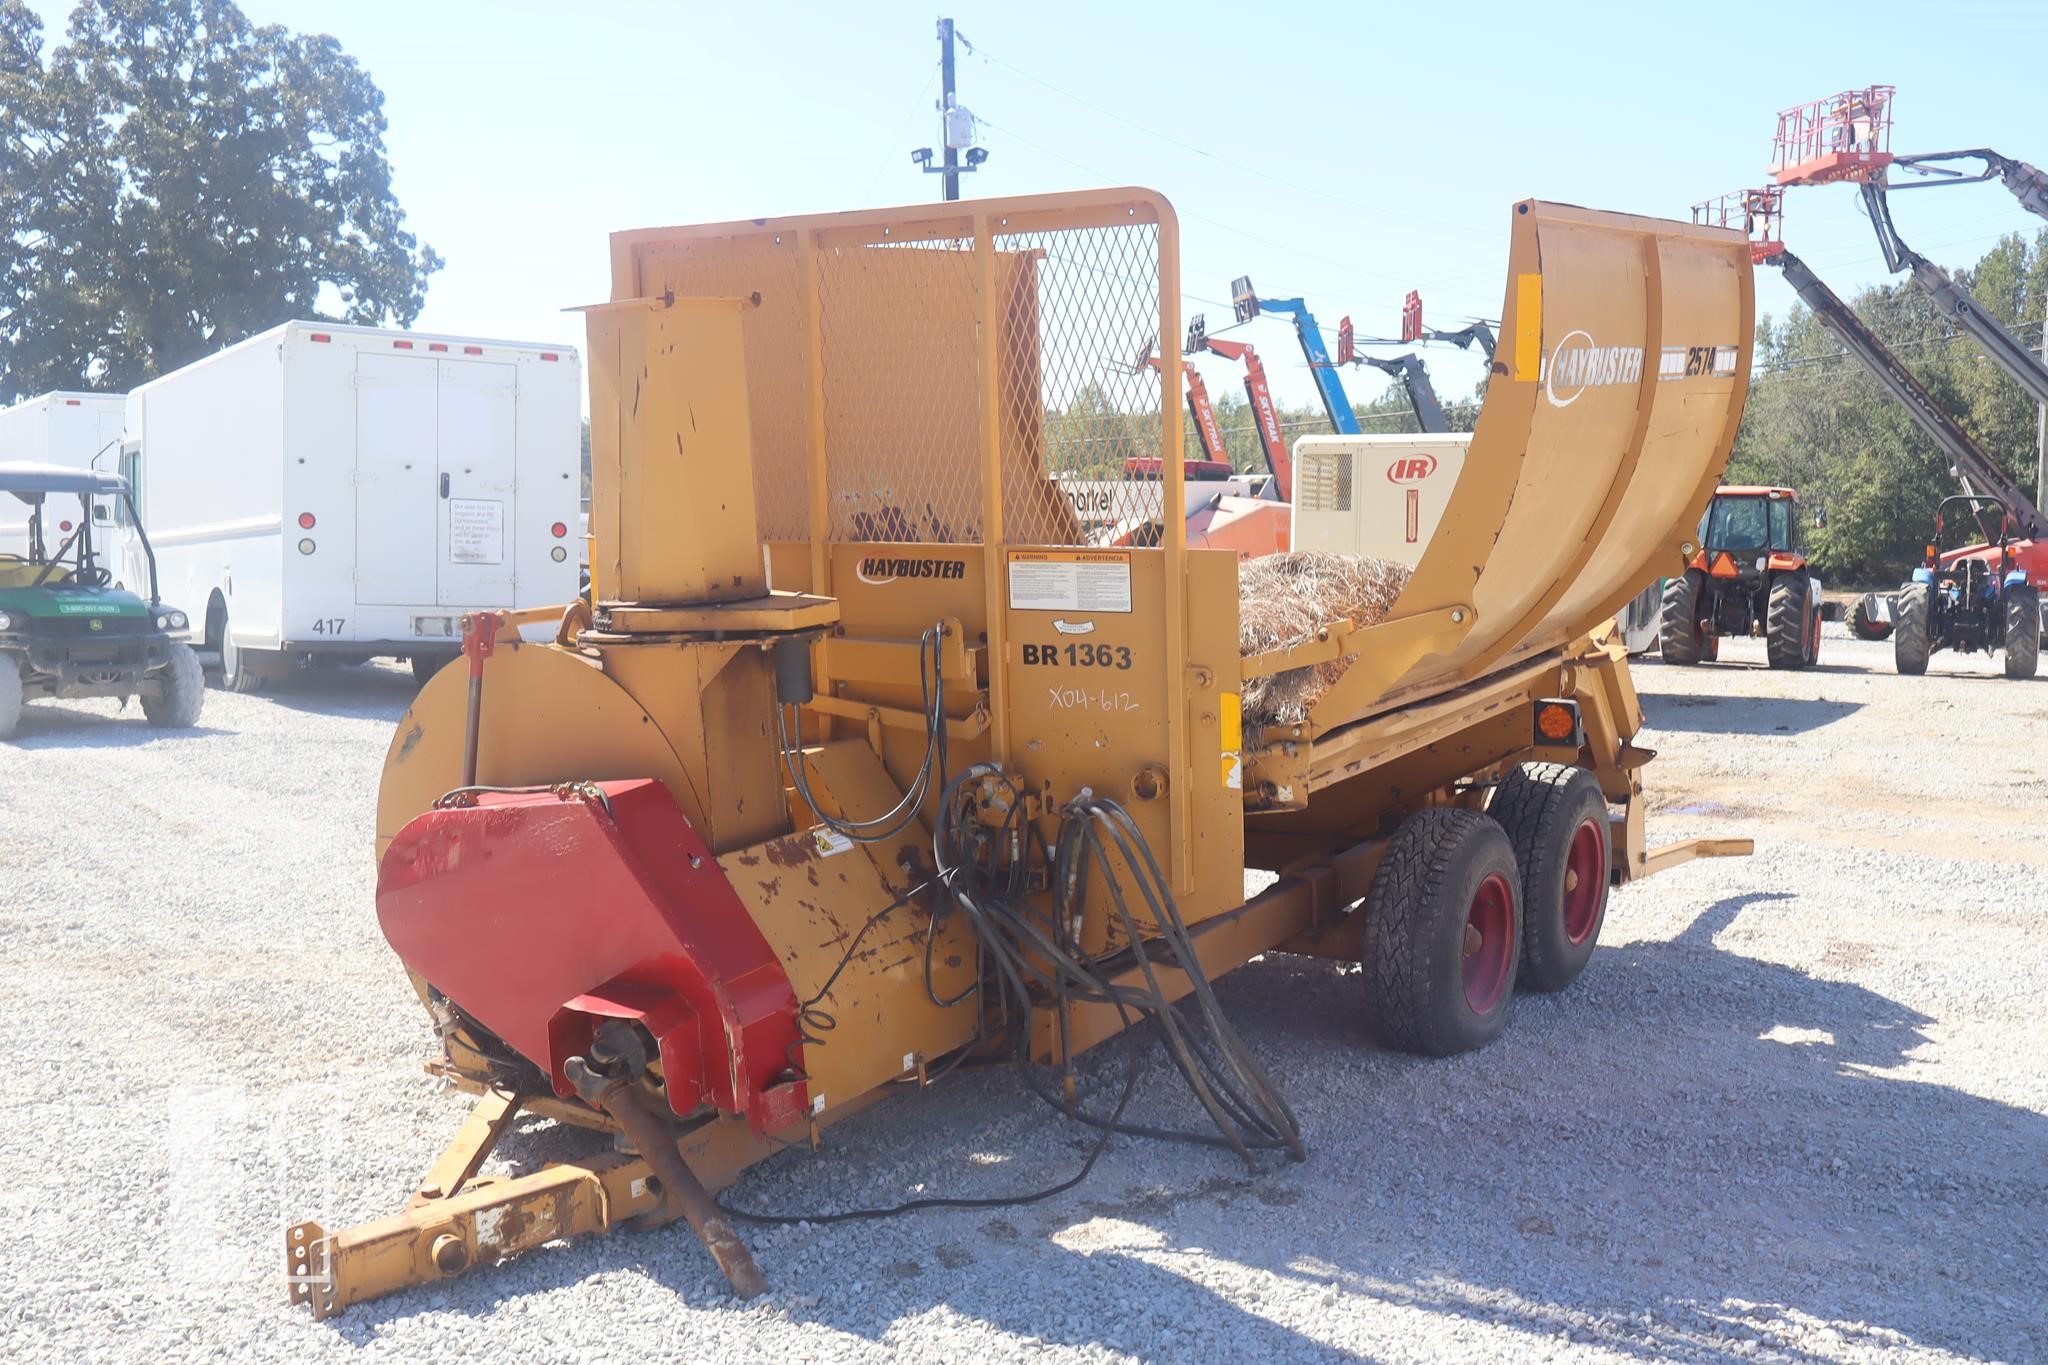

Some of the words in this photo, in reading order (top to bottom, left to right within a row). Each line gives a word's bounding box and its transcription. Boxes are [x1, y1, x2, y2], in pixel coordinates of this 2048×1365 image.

[1554, 346, 1643, 389] HAYBUSTER
[1685, 346, 1717, 377] 2574
[1258, 395, 1281, 444] SKYTRAK
[1395, 459, 1429, 479] IR
[862, 559, 965, 579] HAYBUSTER
[312, 618, 346, 635] 417
[1022, 643, 1060, 666] BR
[1064, 643, 1132, 670] 1363
